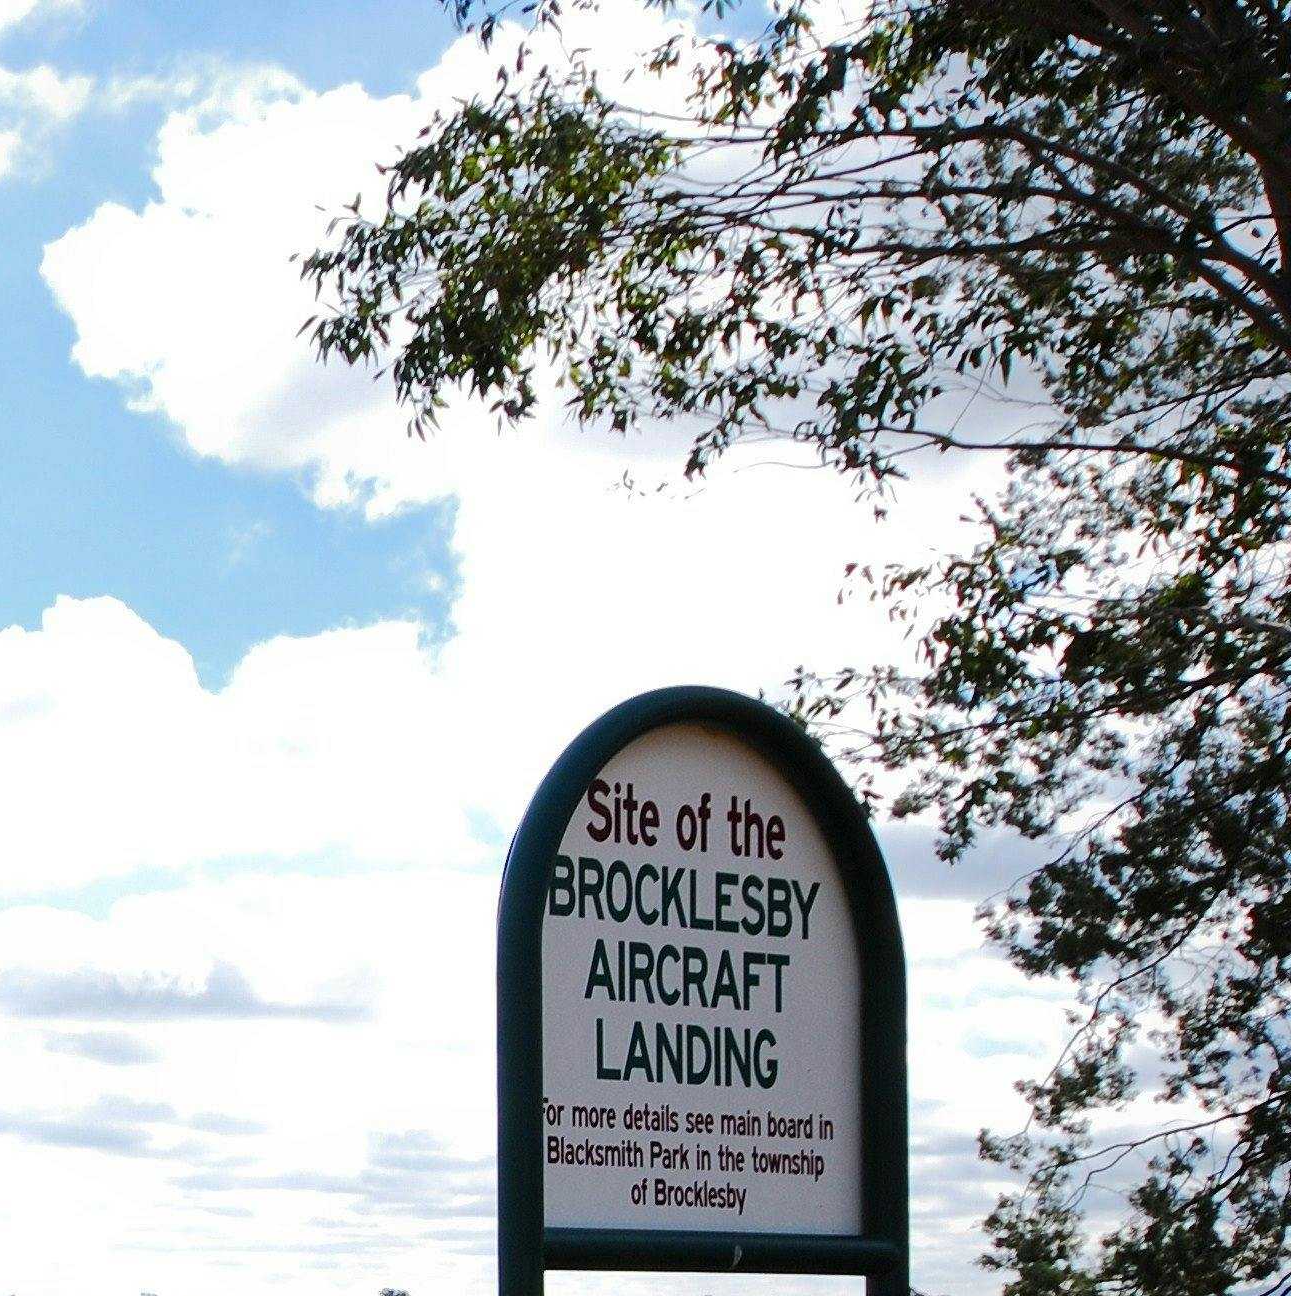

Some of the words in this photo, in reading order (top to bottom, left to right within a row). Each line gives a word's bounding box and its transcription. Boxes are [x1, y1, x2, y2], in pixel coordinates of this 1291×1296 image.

[586, 779, 660, 847] Site
[676, 793, 711, 852] of
[727, 796, 786, 860] the
[548, 855, 820, 940] BROCKLESBY
[584, 938, 790, 1013] AIRCRAFT
[596, 1018, 779, 1089] LANDING
[572, 1105, 616, 1129] more
[623, 1103, 679, 1133] details
[686, 1112, 714, 1133] see
[720, 1110, 761, 1137] main
[768, 1111, 813, 1140] board
[819, 1115, 833, 1140] in
[547, 1136, 644, 1168] Blacksmith
[650, 1141, 690, 1170] Park
[696, 1144, 711, 1171] in
[718, 1145, 745, 1173] the
[752, 1146, 825, 1182] township
[631, 1178, 648, 1205] of
[654, 1178, 747, 1215] Brocklesby
